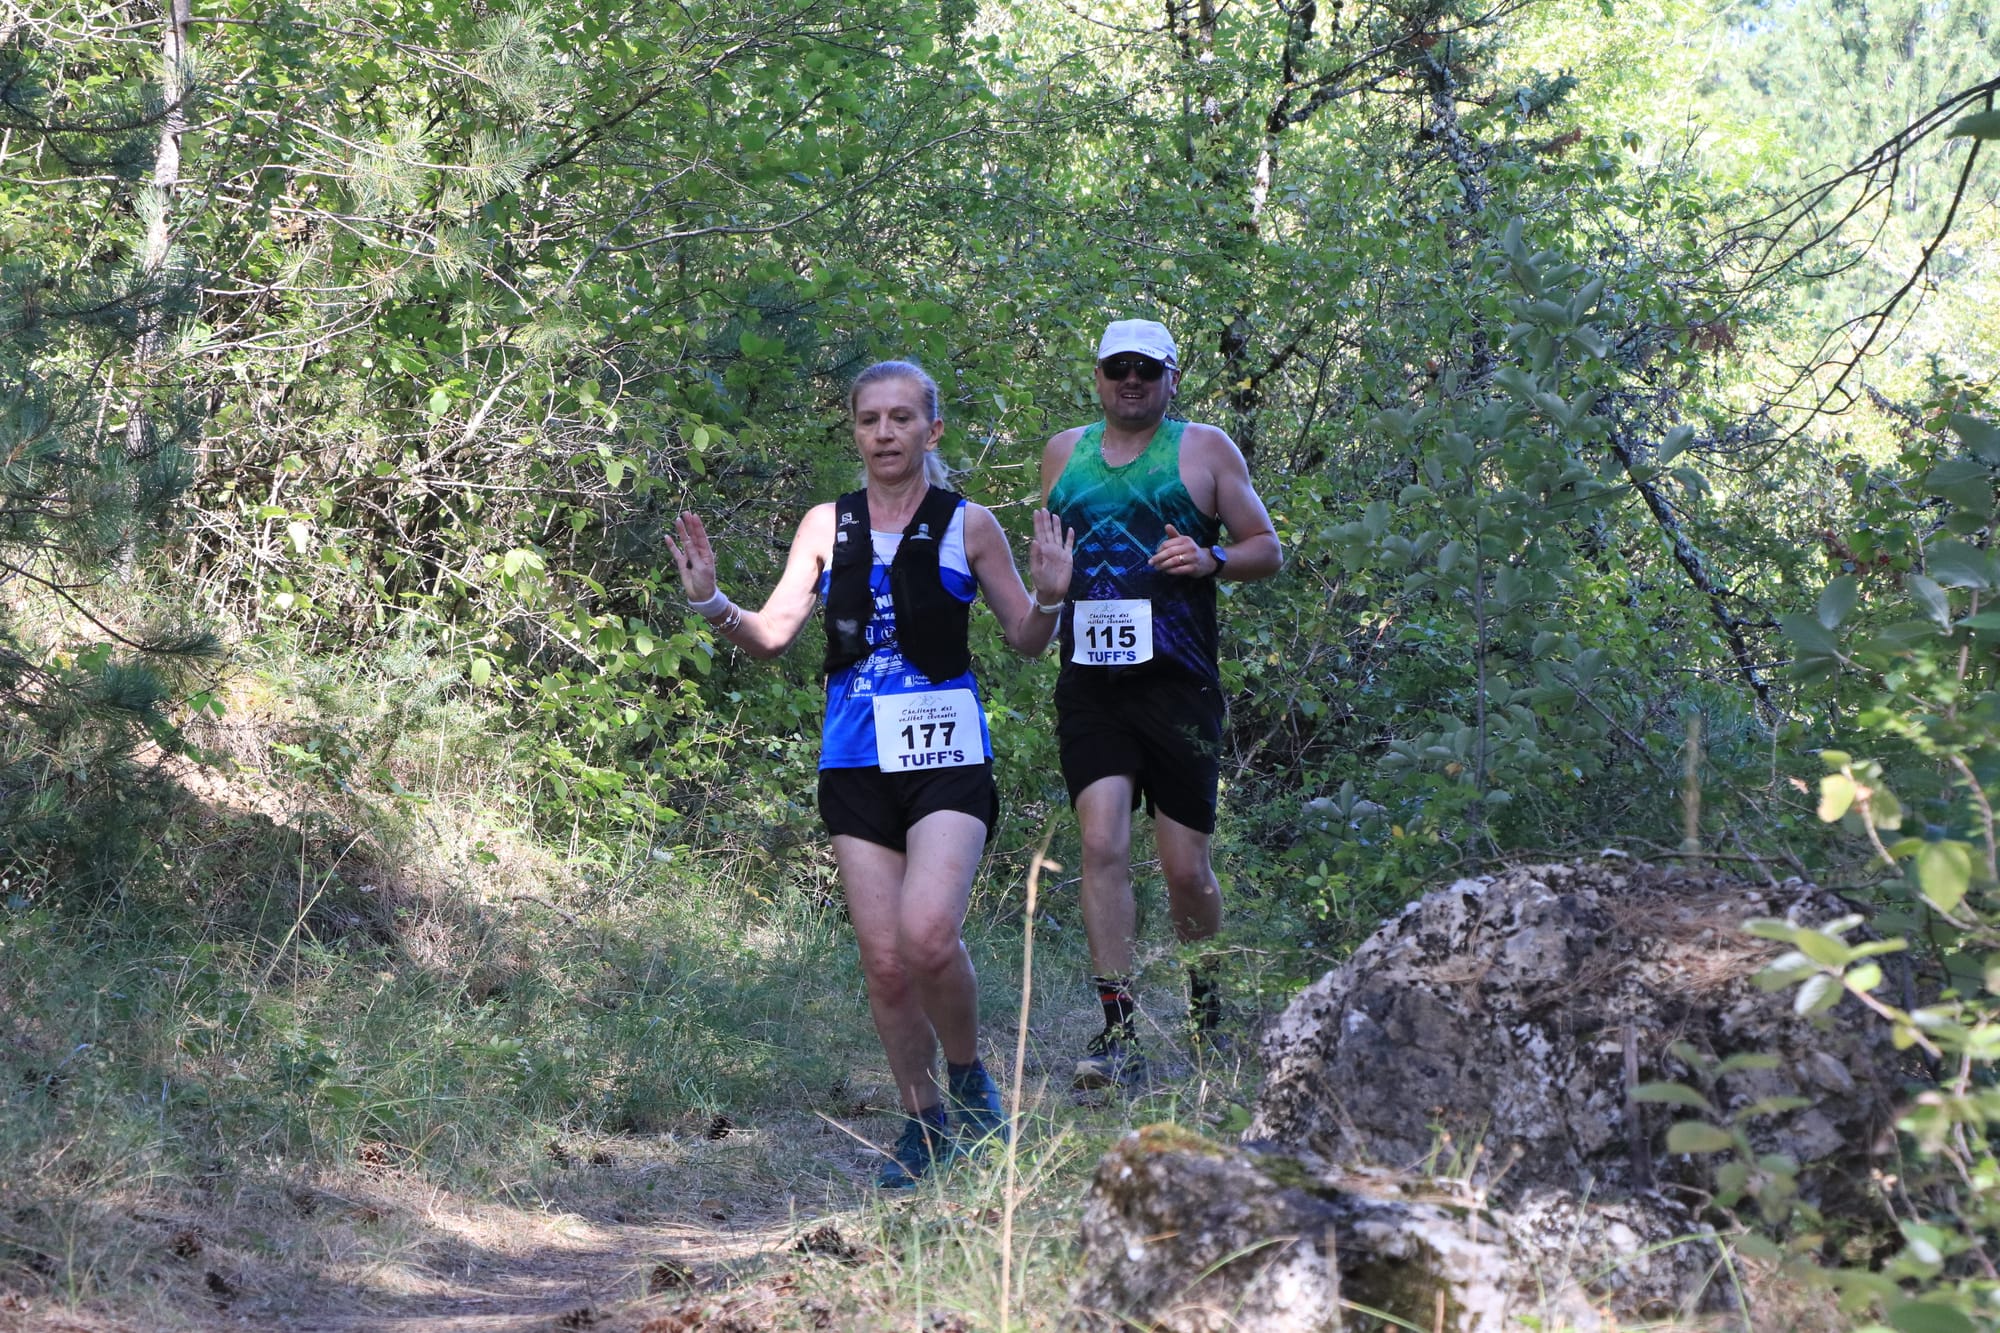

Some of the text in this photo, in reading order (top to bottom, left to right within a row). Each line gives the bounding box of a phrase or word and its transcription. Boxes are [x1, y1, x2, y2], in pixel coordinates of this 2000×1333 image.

[1086, 626, 1136, 648] 115
[1087, 651, 1136, 662] TUFF'S
[902, 707, 937, 716] Challenge
[902, 721, 956, 750] 177
[898, 750, 965, 767] TUFF'S
